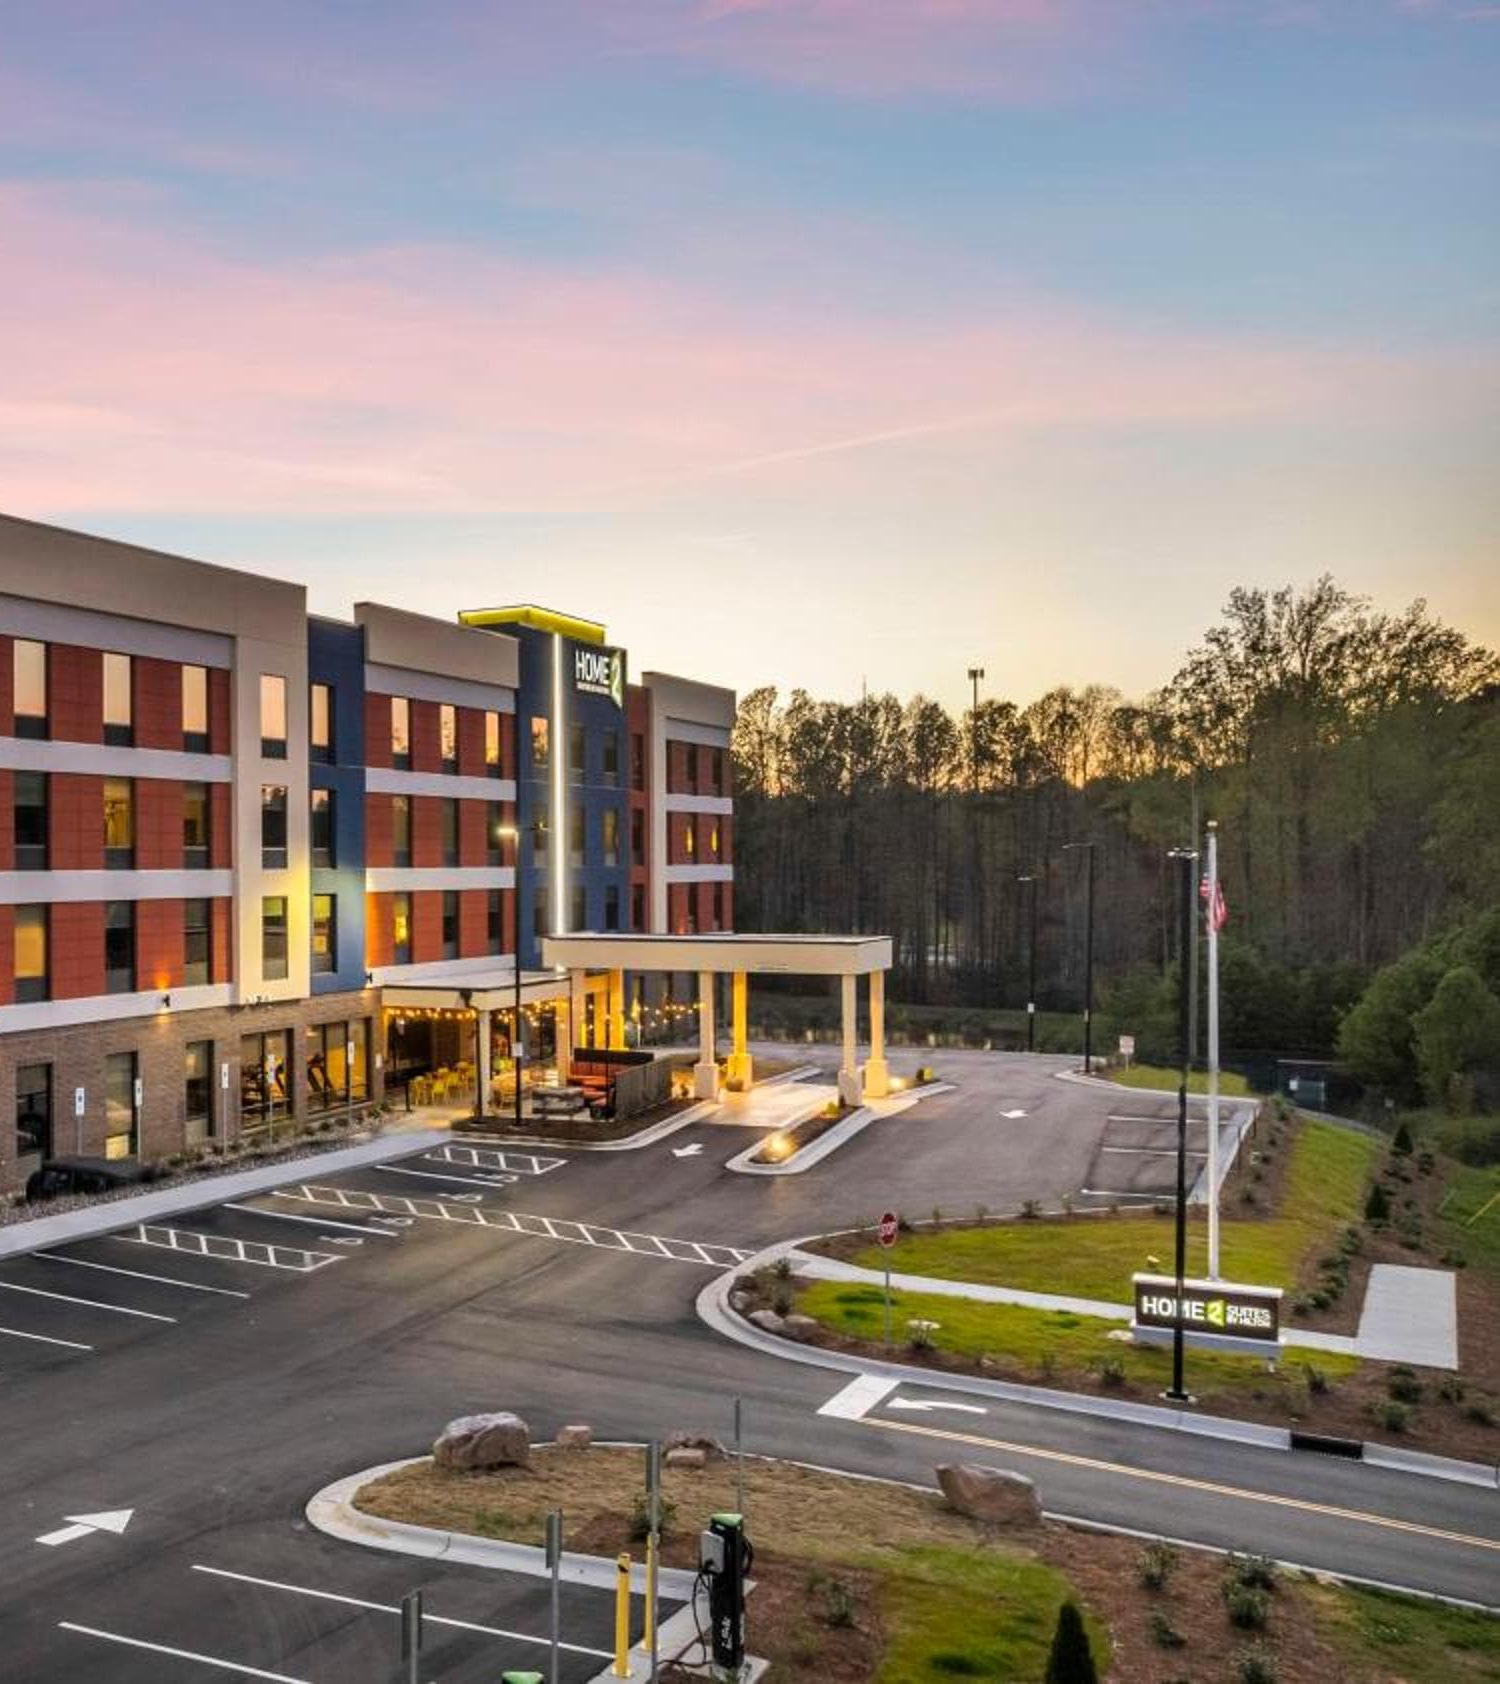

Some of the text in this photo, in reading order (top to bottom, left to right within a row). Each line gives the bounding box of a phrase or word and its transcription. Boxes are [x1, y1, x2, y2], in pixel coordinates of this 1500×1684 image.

[575, 649, 622, 708] HOME 2
[1207, 1301, 1224, 1327] 2
